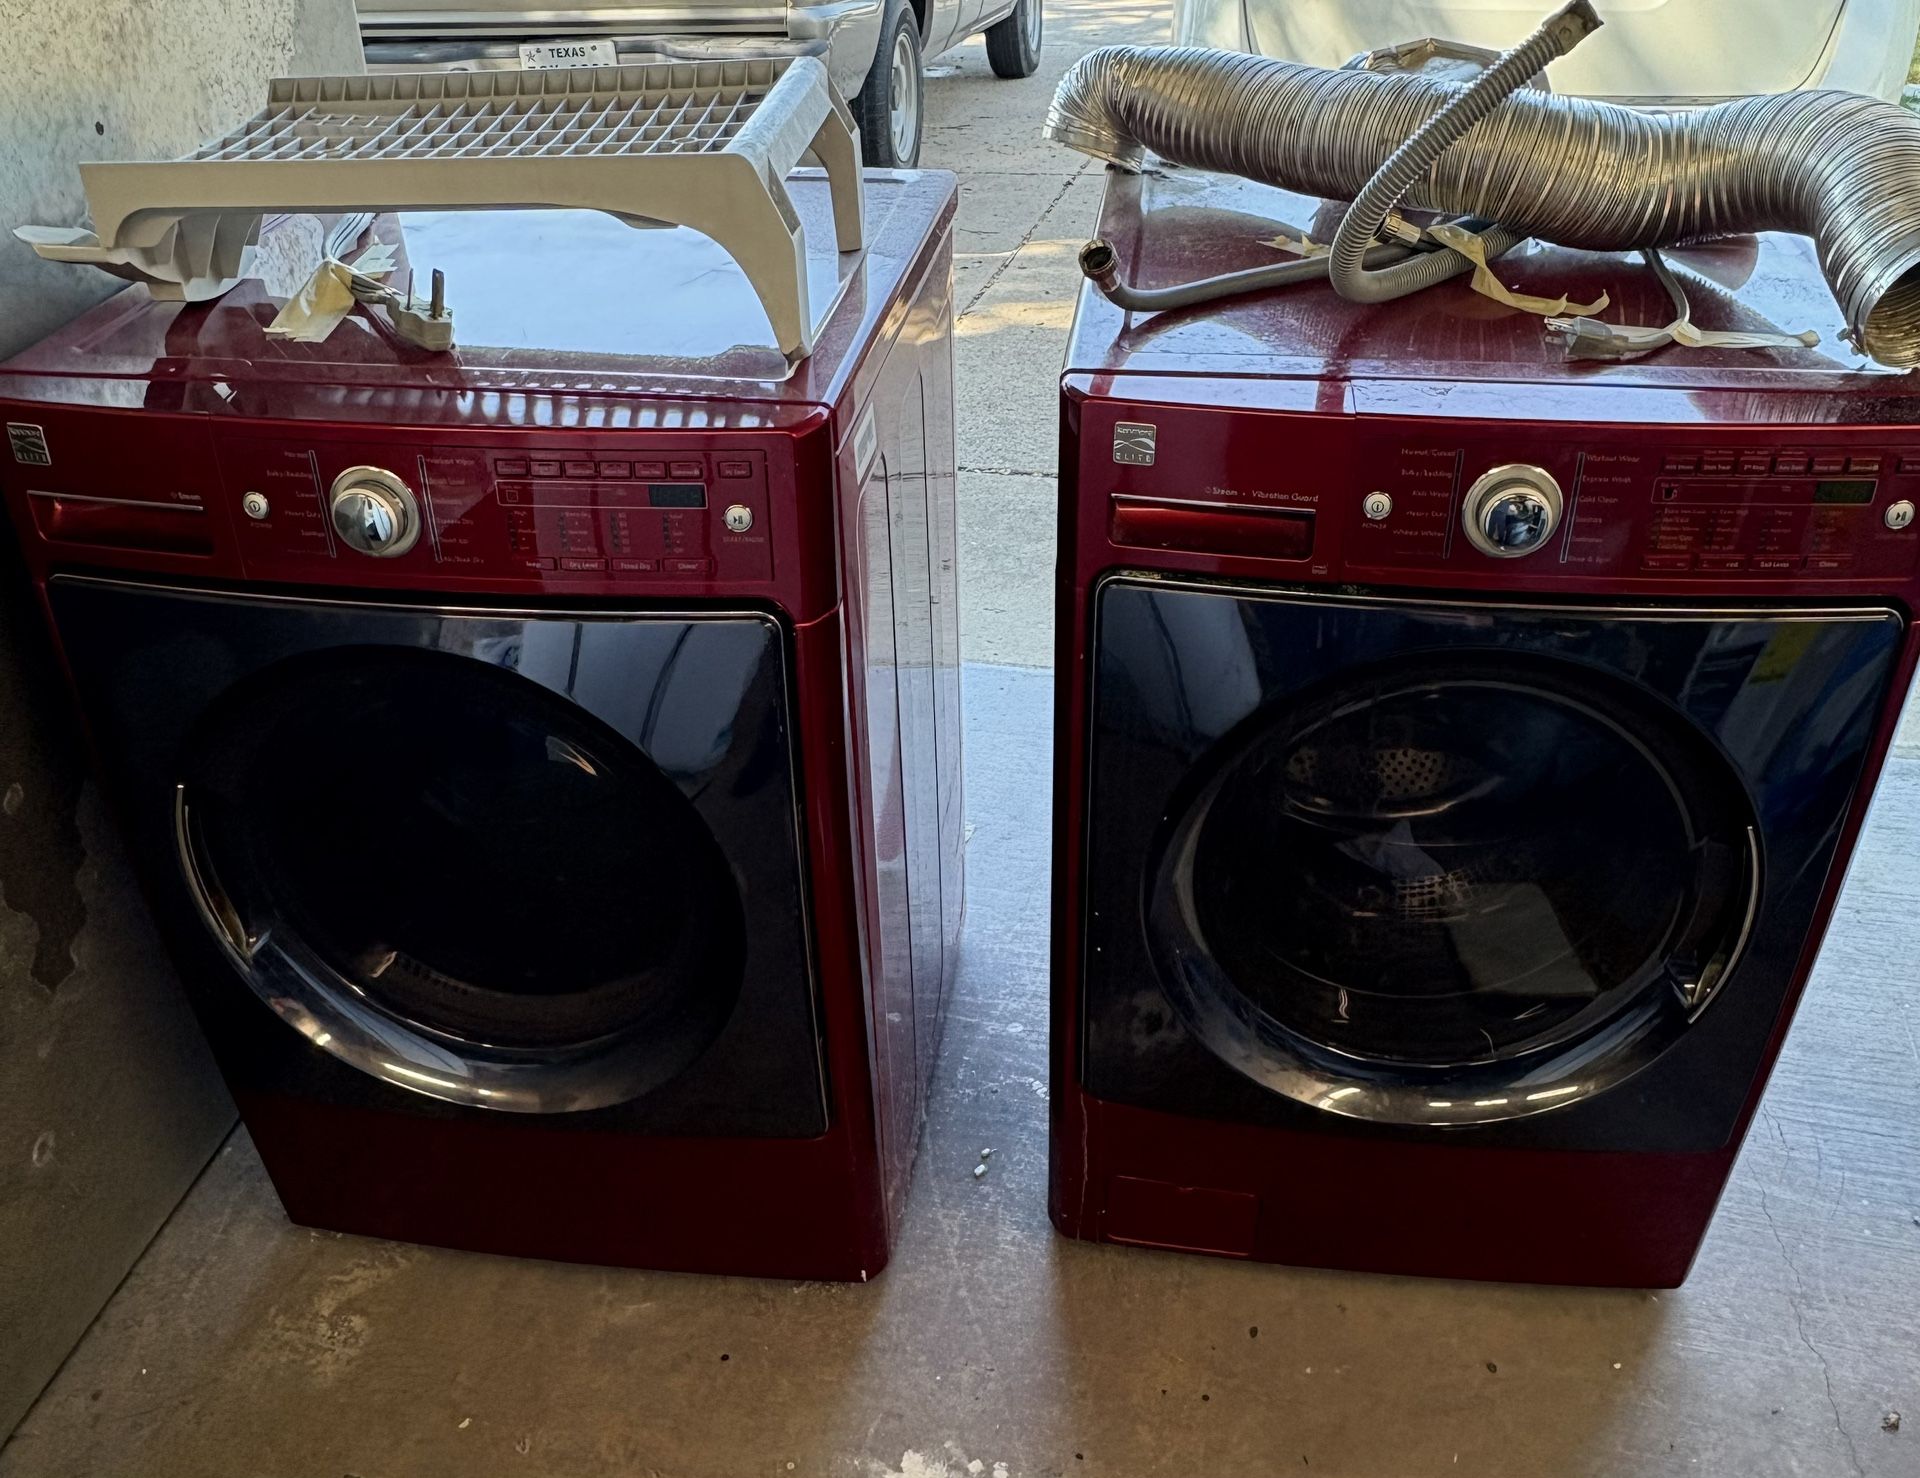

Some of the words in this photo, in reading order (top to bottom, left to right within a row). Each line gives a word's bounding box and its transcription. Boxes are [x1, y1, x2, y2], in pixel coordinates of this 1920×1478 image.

[548, 46, 586, 58] TEXAS
[1115, 452, 1152, 463] ELITE
[1212, 487, 1238, 496] Steam
[1252, 490, 1290, 500] Vibration
[1291, 493, 1319, 502] Guard
